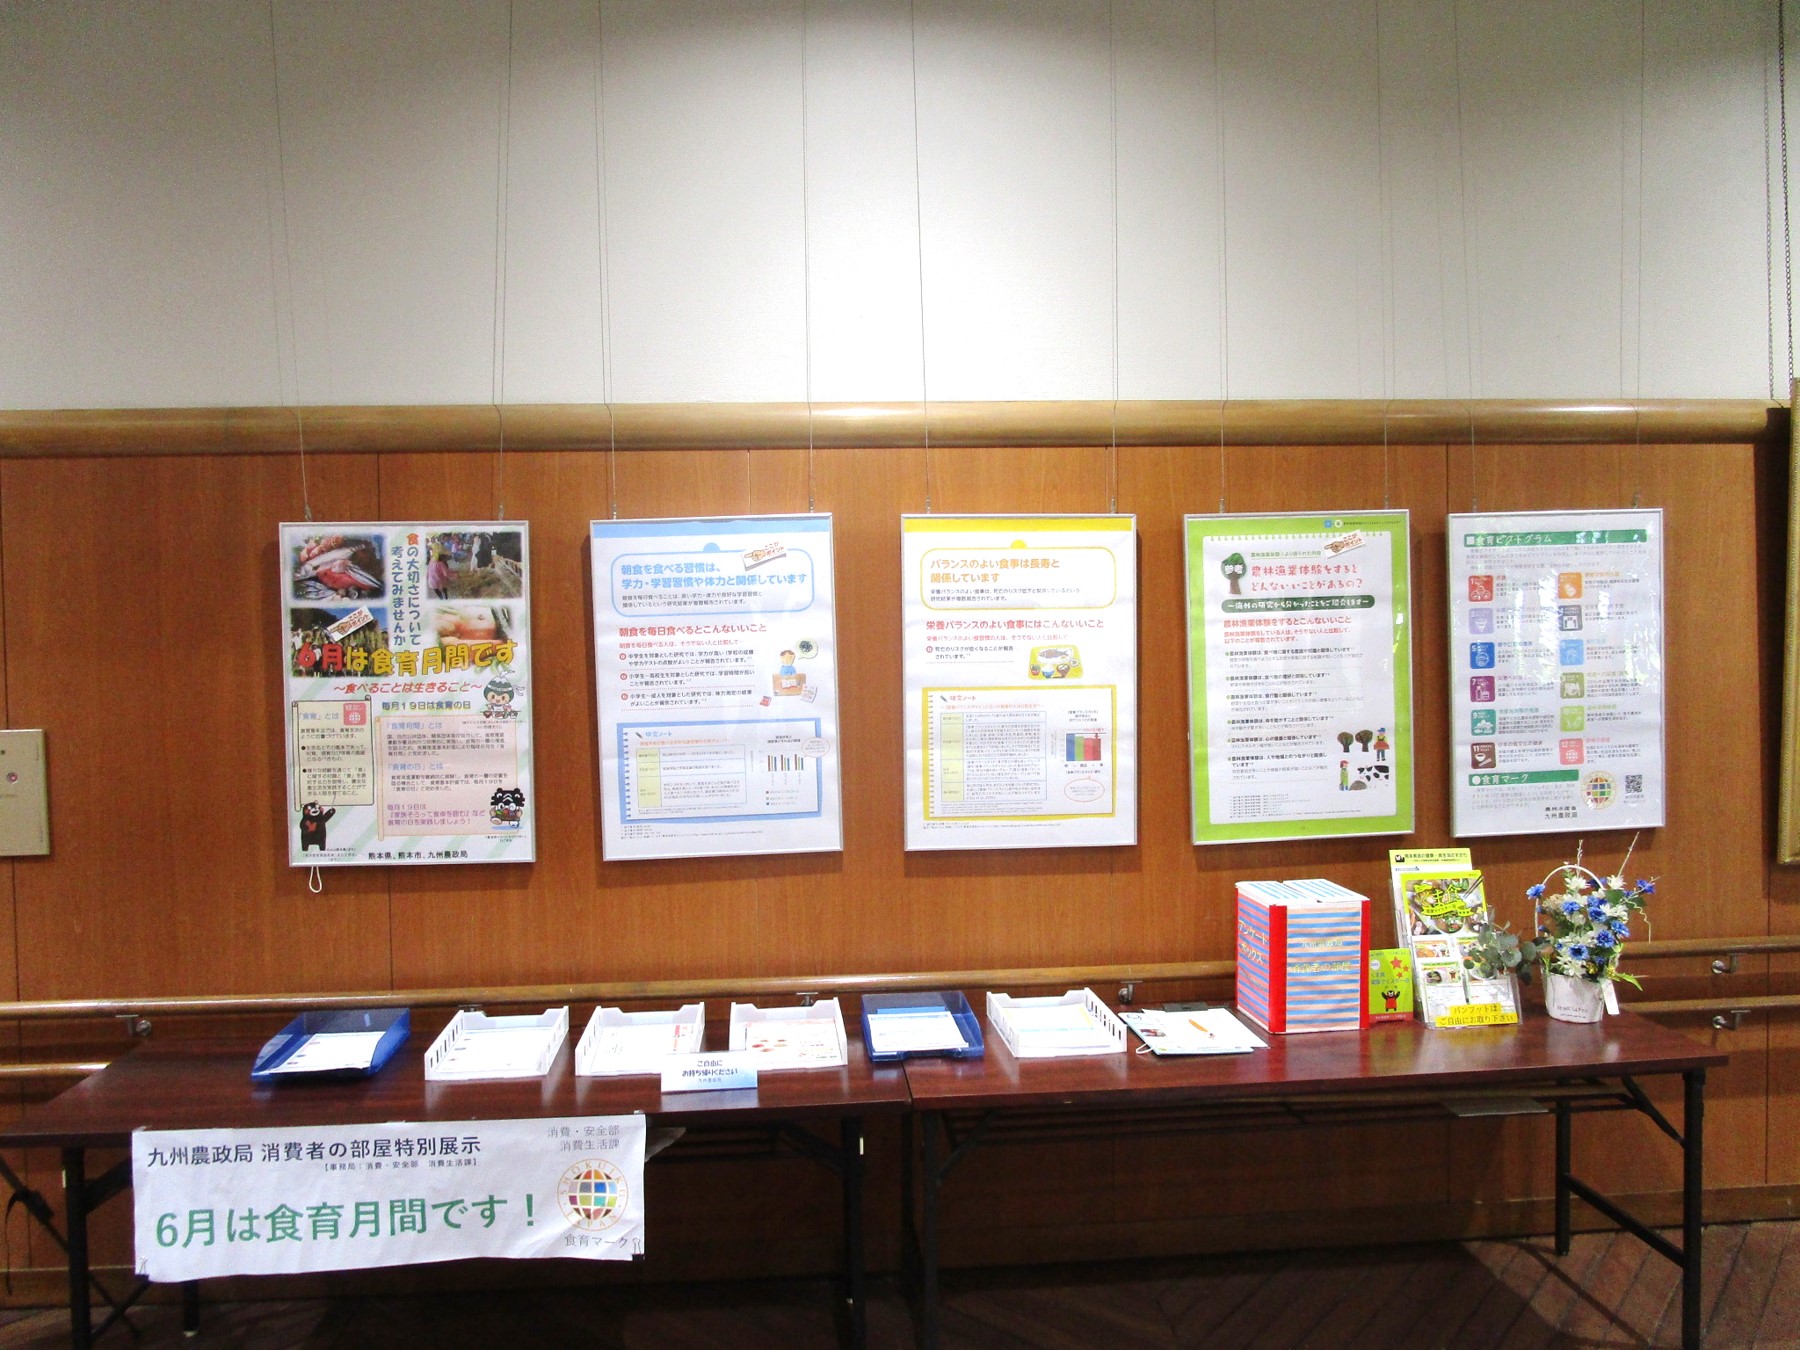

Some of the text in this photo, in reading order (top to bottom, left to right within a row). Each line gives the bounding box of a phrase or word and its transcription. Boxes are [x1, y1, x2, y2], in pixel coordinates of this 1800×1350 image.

[1476, 535, 1552, 546] 食育ピクトグラム
[621, 563, 721, 576] 朝食を食べる習慣は、
[930, 558, 1060, 570] バランスのよい食事は長寿と
[1251, 563, 1358, 577] 農林漁業体験をすると
[621, 573, 808, 589] 学力・学習習慣や体力と関係しています
[930, 572, 1000, 584] 関係しています
[406, 533, 421, 646] 食の大切さについて
[1251, 578, 1363, 592] どんないいことがあるの？
[391, 546, 407, 646] 考えてみませんか
[926, 619, 1104, 630] 栄養バランスのよい食事にはこんないいこと
[1223, 616, 1352, 628] 農林漁業体験をするとこんないいこと
[619, 623, 768, 638] 朝食を毎日食べるとこんないいこと
[298, 638, 518, 677] 6月は食育月間です
[1481, 774, 1529, 785] 食育マーク
[368, 849, 468, 860] 熊本県、熊本市、九州農政局
[1439, 1014, 1514, 1025] ご自由にお取り下さい
[697, 1059, 723, 1068] ご自由に
[547, 1124, 620, 1138] 消費・安全部
[147, 1136, 481, 1167] 九州農政局 消費者の部屋特別展示
[560, 1139, 621, 1152] 消費生活課
[156, 1193, 535, 1249] 6月は食育月間です！
[564, 1233, 628, 1248] 食育マーク
